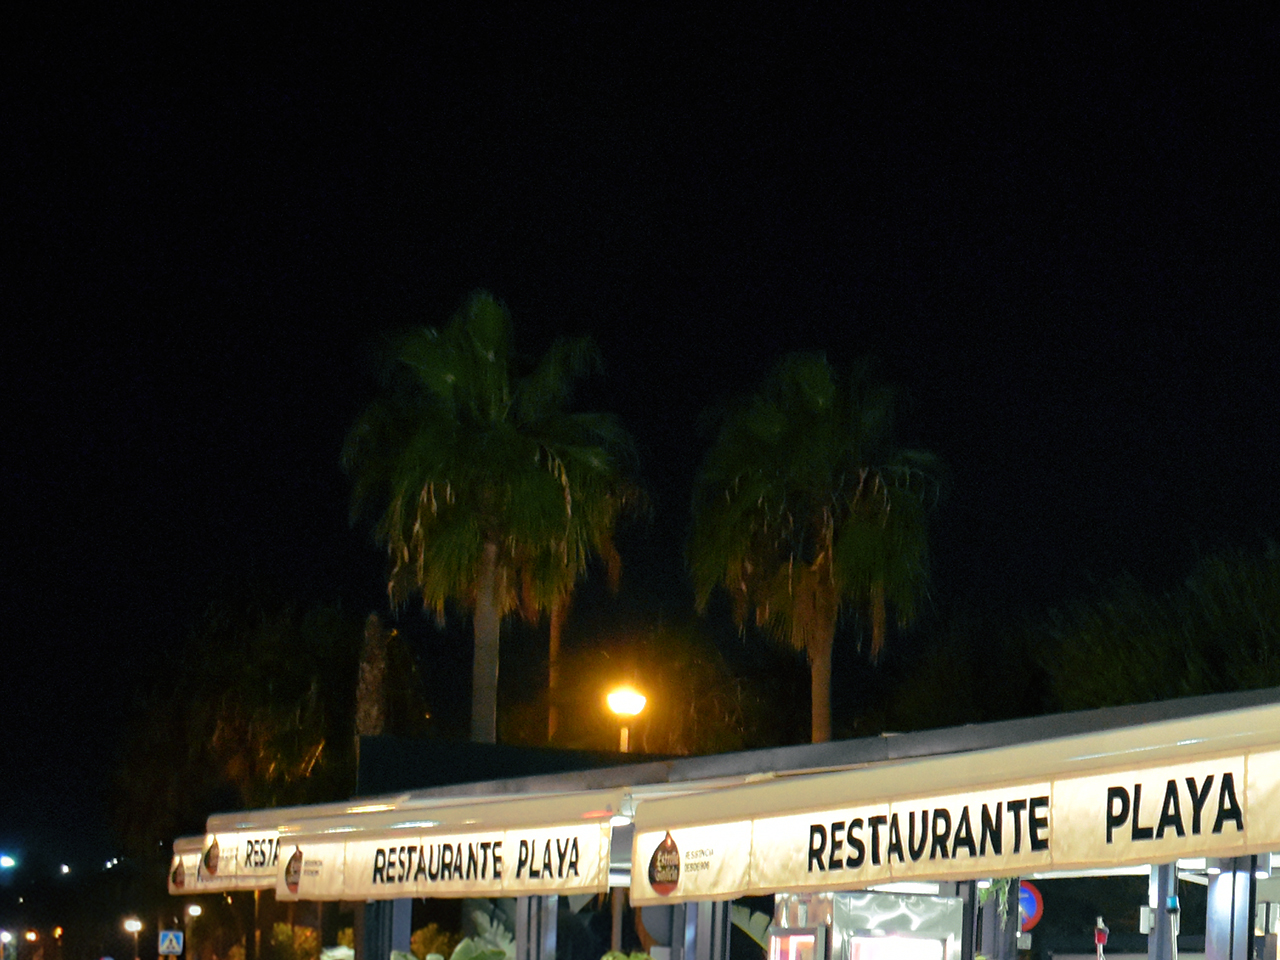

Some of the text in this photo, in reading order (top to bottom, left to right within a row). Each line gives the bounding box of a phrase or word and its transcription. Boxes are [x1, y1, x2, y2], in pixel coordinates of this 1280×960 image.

[807, 772, 1244, 873] RESTAURANTE PLAYA
[372, 836, 580, 885] RESTAURANTE PLAYA
